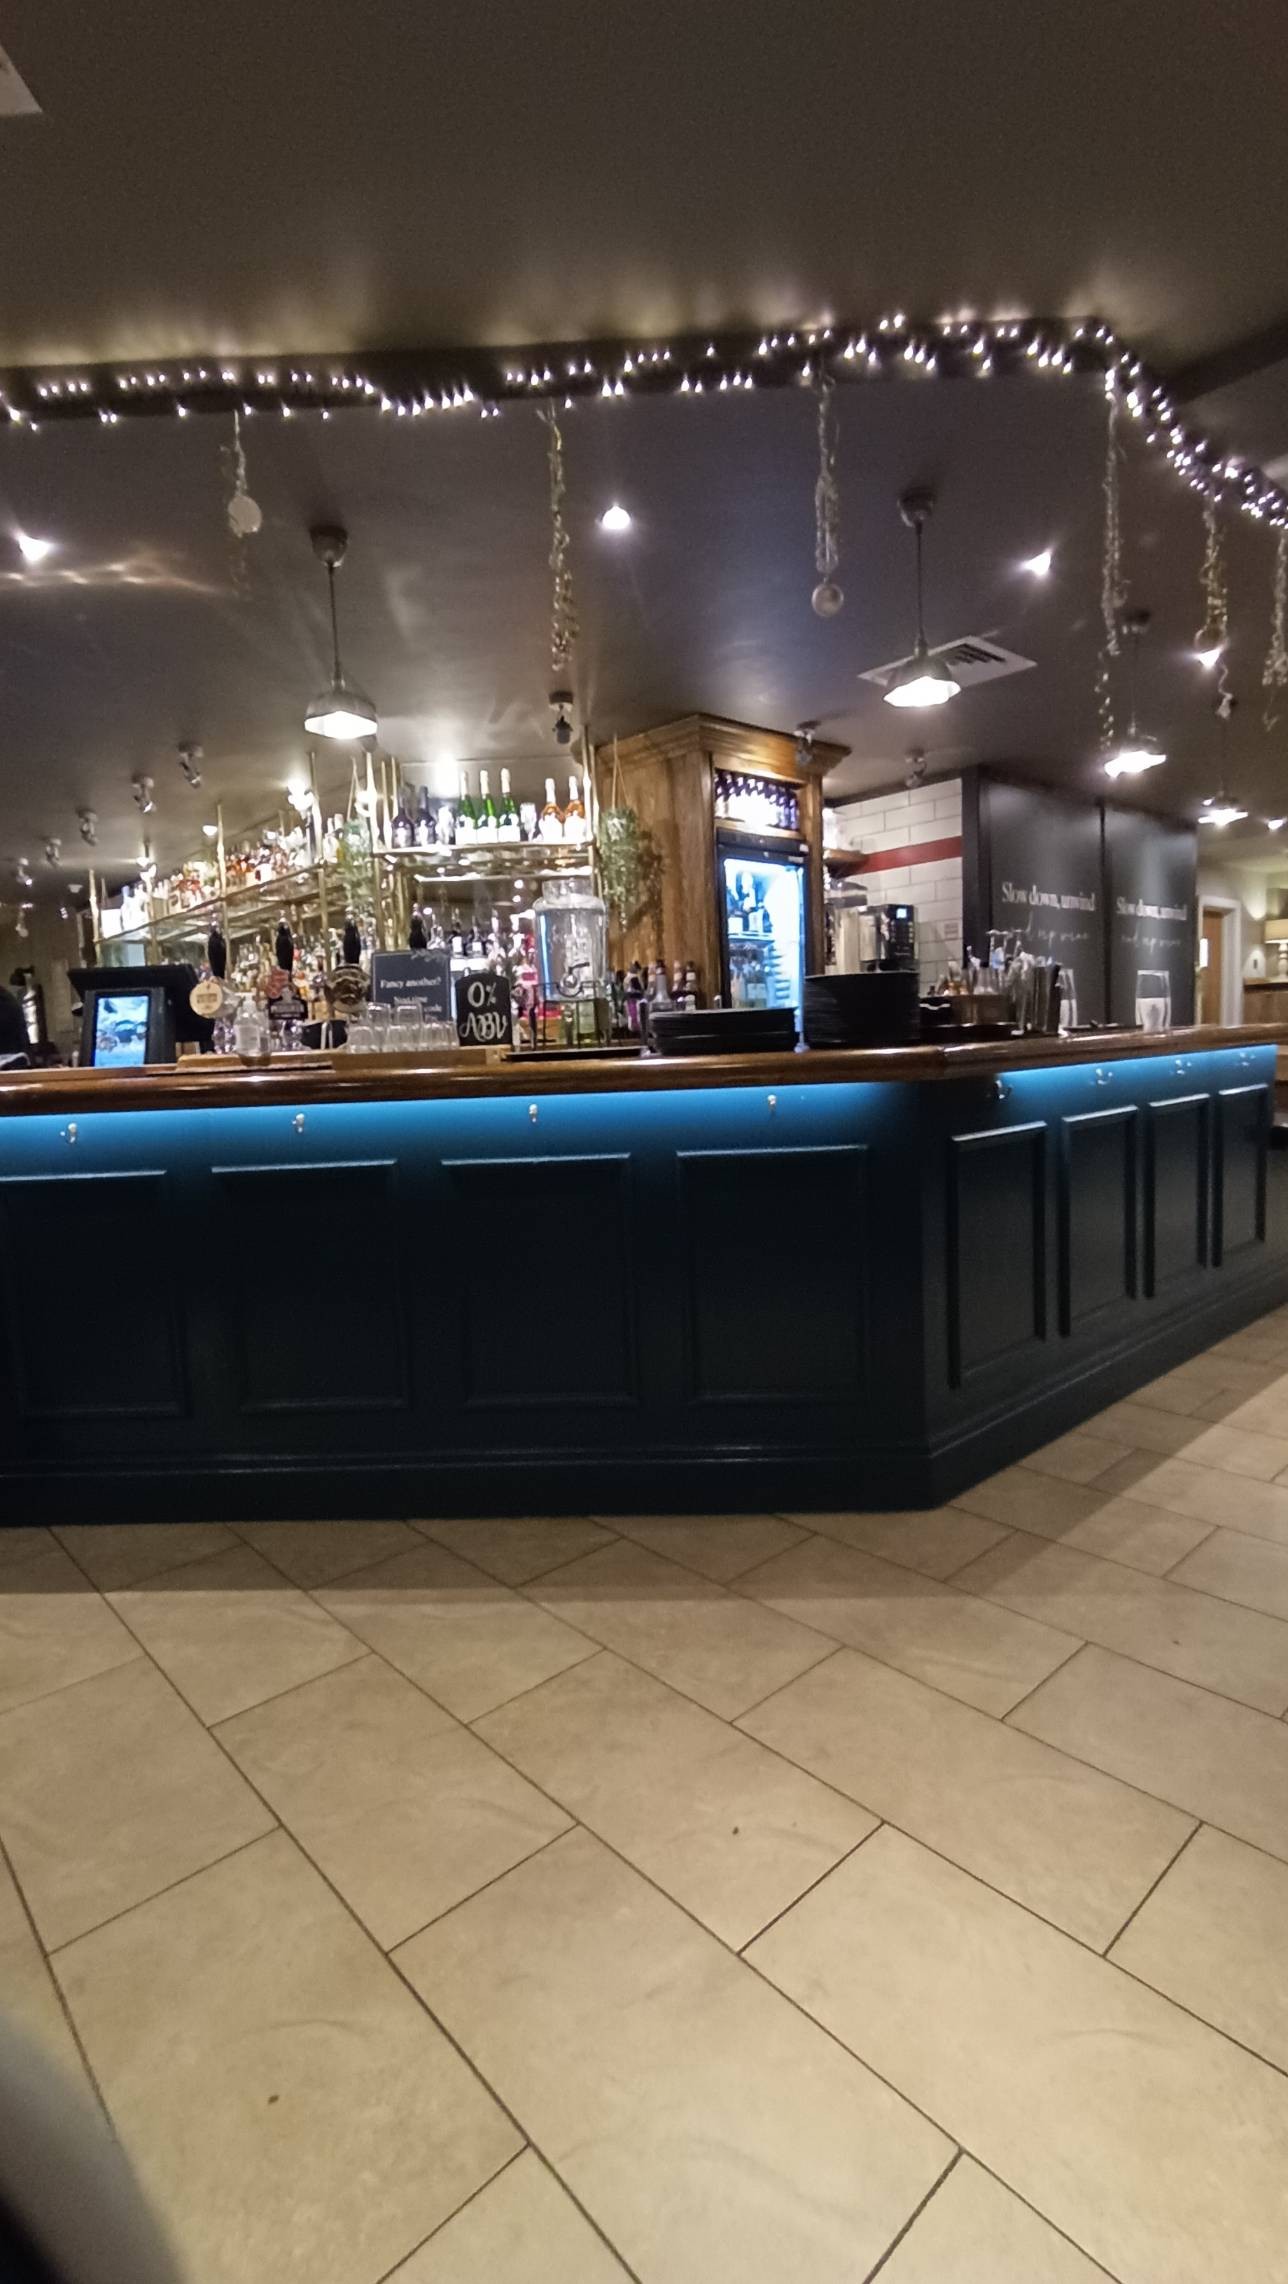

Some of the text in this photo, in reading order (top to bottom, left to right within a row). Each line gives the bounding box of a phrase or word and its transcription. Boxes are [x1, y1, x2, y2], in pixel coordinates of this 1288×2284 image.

[1002, 882, 1027, 904] Slow
[1061, 892, 1095, 911] unwind
[380, 979, 404, 989] Fancy
[467, 981, 497, 1008] 0%
[459, 1011, 507, 1042] ABV
